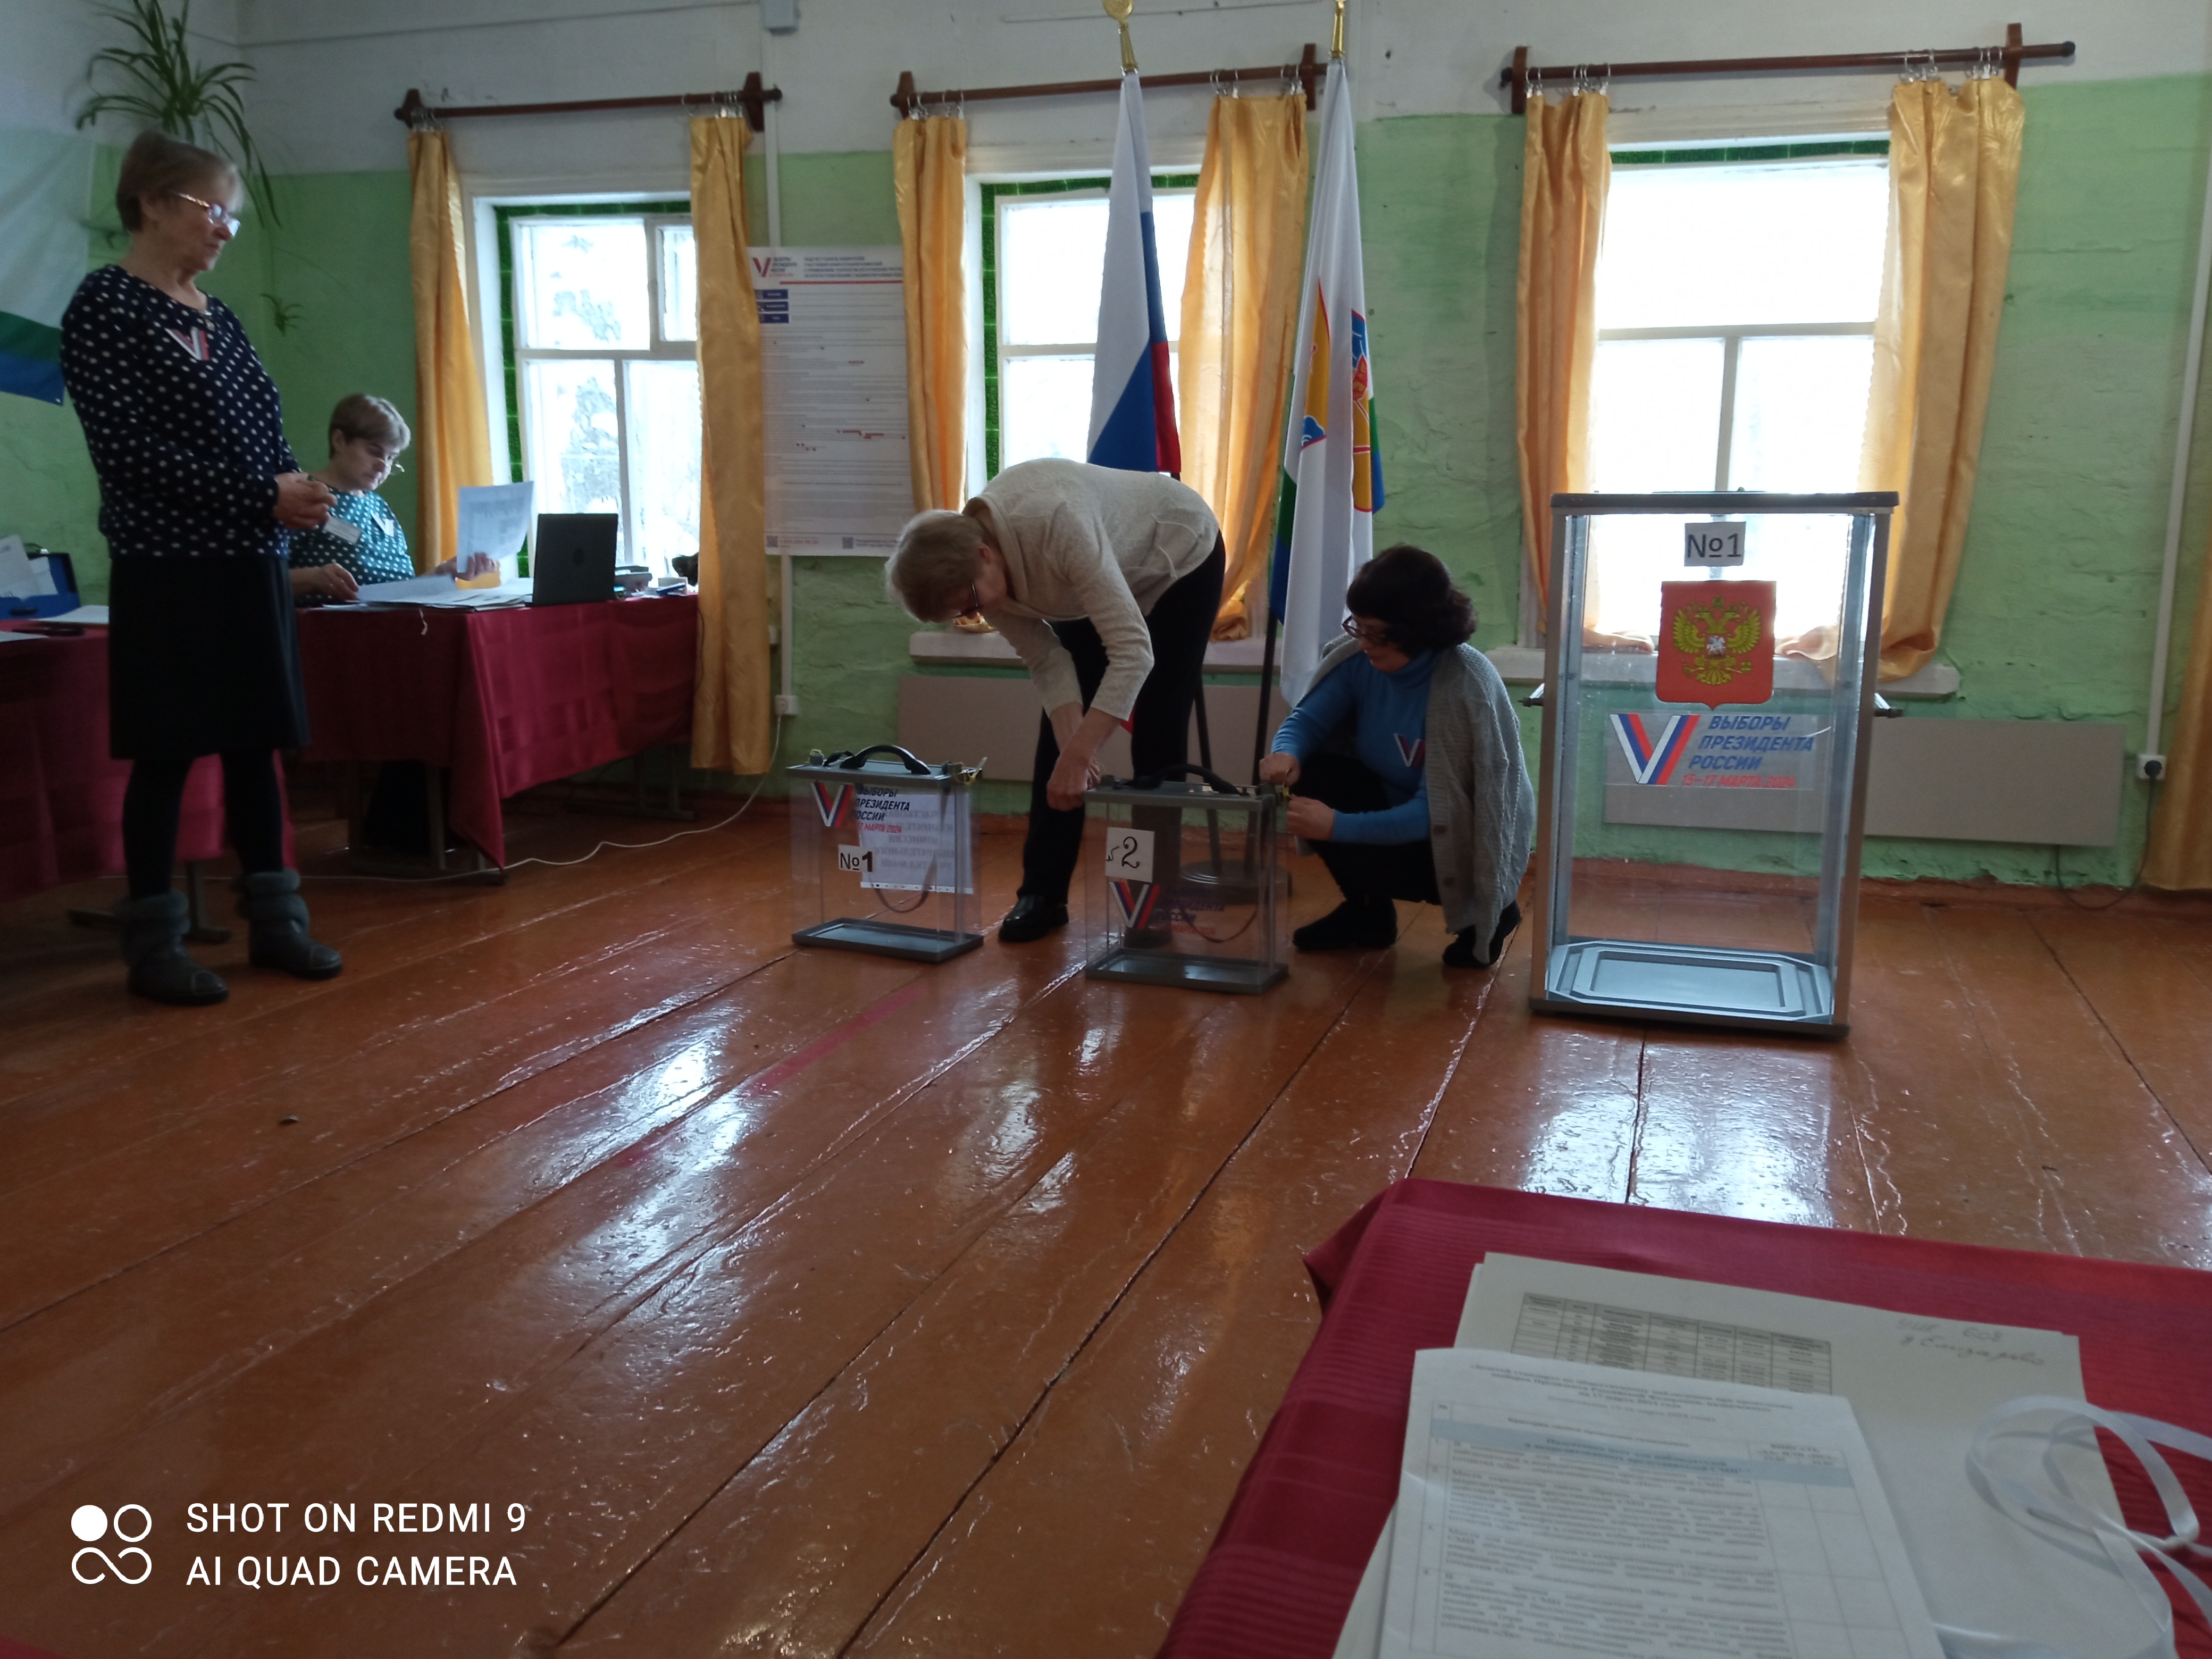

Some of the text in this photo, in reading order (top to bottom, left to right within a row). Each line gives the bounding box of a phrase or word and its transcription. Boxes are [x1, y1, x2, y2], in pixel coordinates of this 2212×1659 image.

[1687, 532, 1742, 558] №1
[1708, 715, 1791, 731] ВЫБОРЫ
[1698, 735, 1814, 752] ПРЕЗИДЕНТА
[1688, 755, 1763, 770] РОССИИ
[1718, 775, 1762, 787] МАРТА
[857, 786, 898, 798] ВЫБОРЫ
[854, 798, 910, 811] ПРЕЗИДЕНТА
[851, 810, 885, 822] РОССИИ
[865, 823, 885, 832] МАРТА
